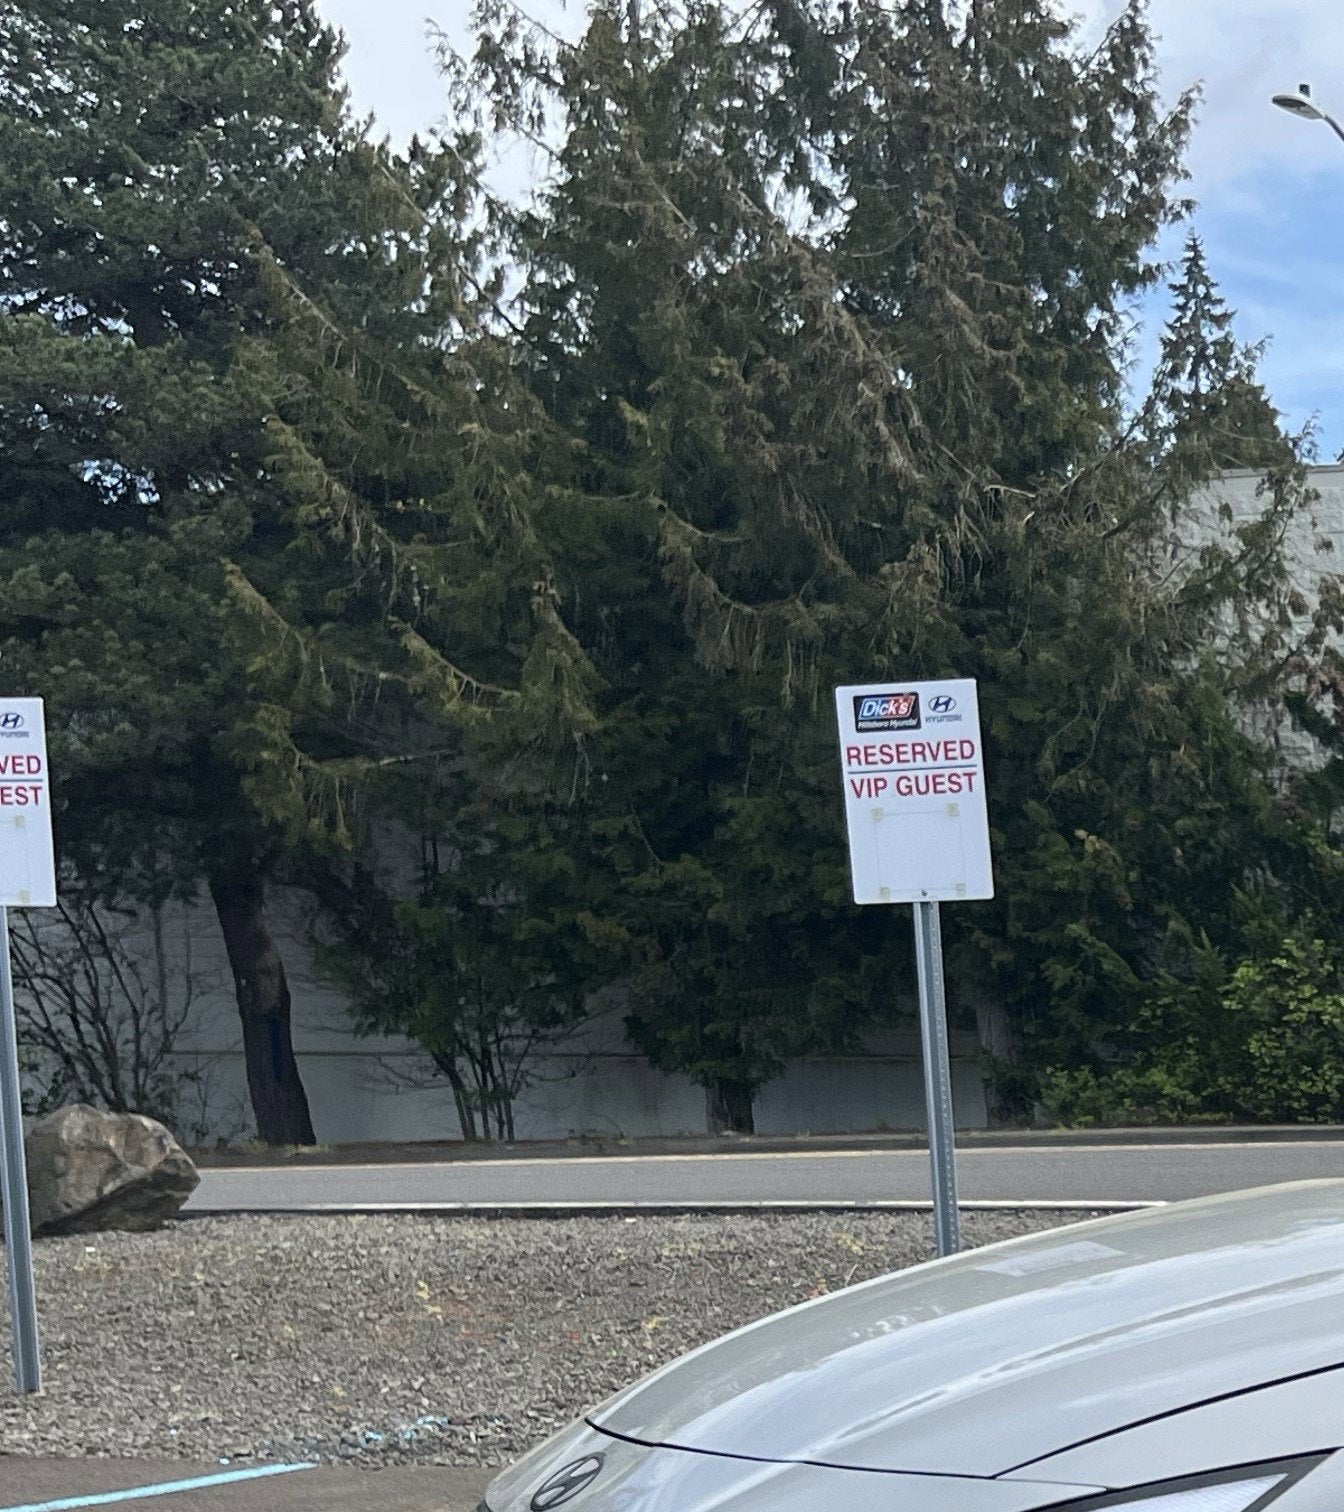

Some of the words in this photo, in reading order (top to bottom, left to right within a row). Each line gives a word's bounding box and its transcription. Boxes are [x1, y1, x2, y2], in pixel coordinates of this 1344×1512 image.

[847, 739, 975, 767] RESERVED
[850, 777, 888, 799] VIP
[896, 772, 977, 797] GUEST
